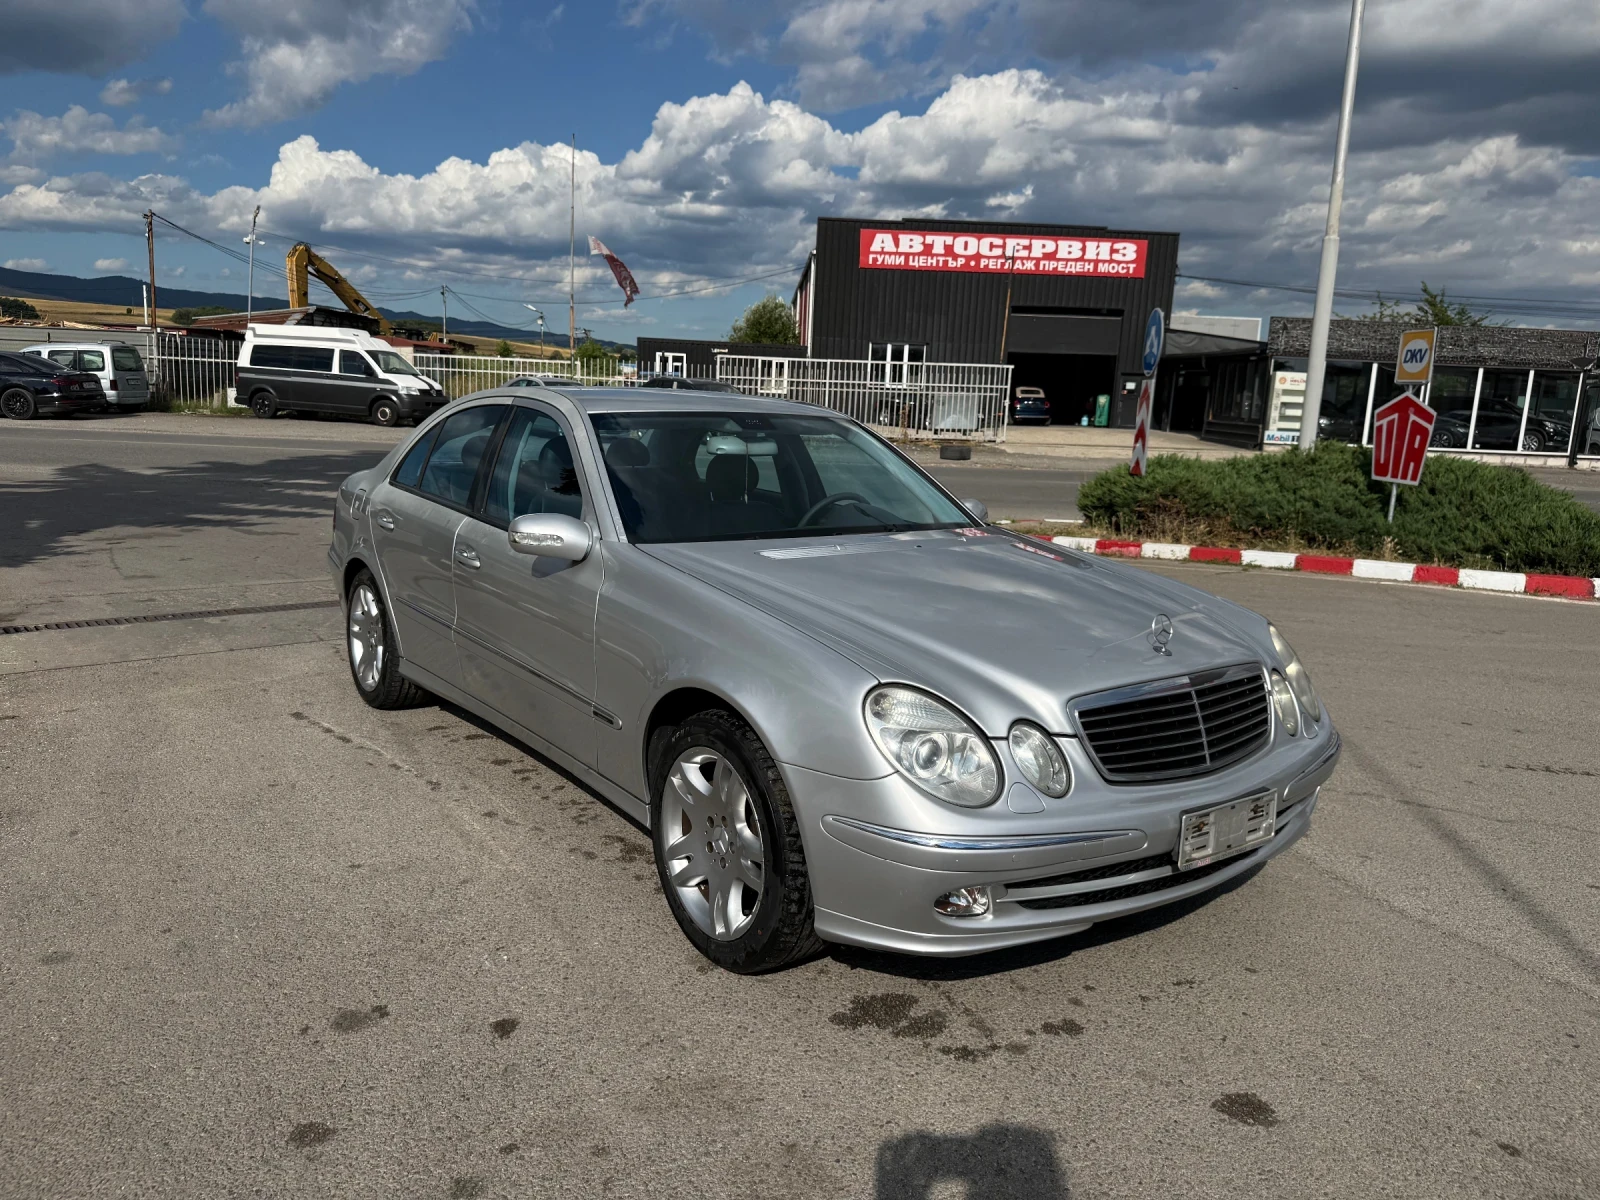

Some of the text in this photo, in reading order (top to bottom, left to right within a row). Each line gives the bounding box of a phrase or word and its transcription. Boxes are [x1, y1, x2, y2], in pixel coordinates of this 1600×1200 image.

[869, 233, 1138, 262] АВТОСЕРВИЗ
[868, 253, 1137, 274] ГУМИ ЦЕНТЪР РЕГЛАЖ ПРЕДЕН МОСТ
[1403, 347, 1428, 364] DKV
[1266, 433, 1290, 442] Mobil
[1373, 393, 1436, 483] UTA
[1197, 856, 1211, 868] Audi
